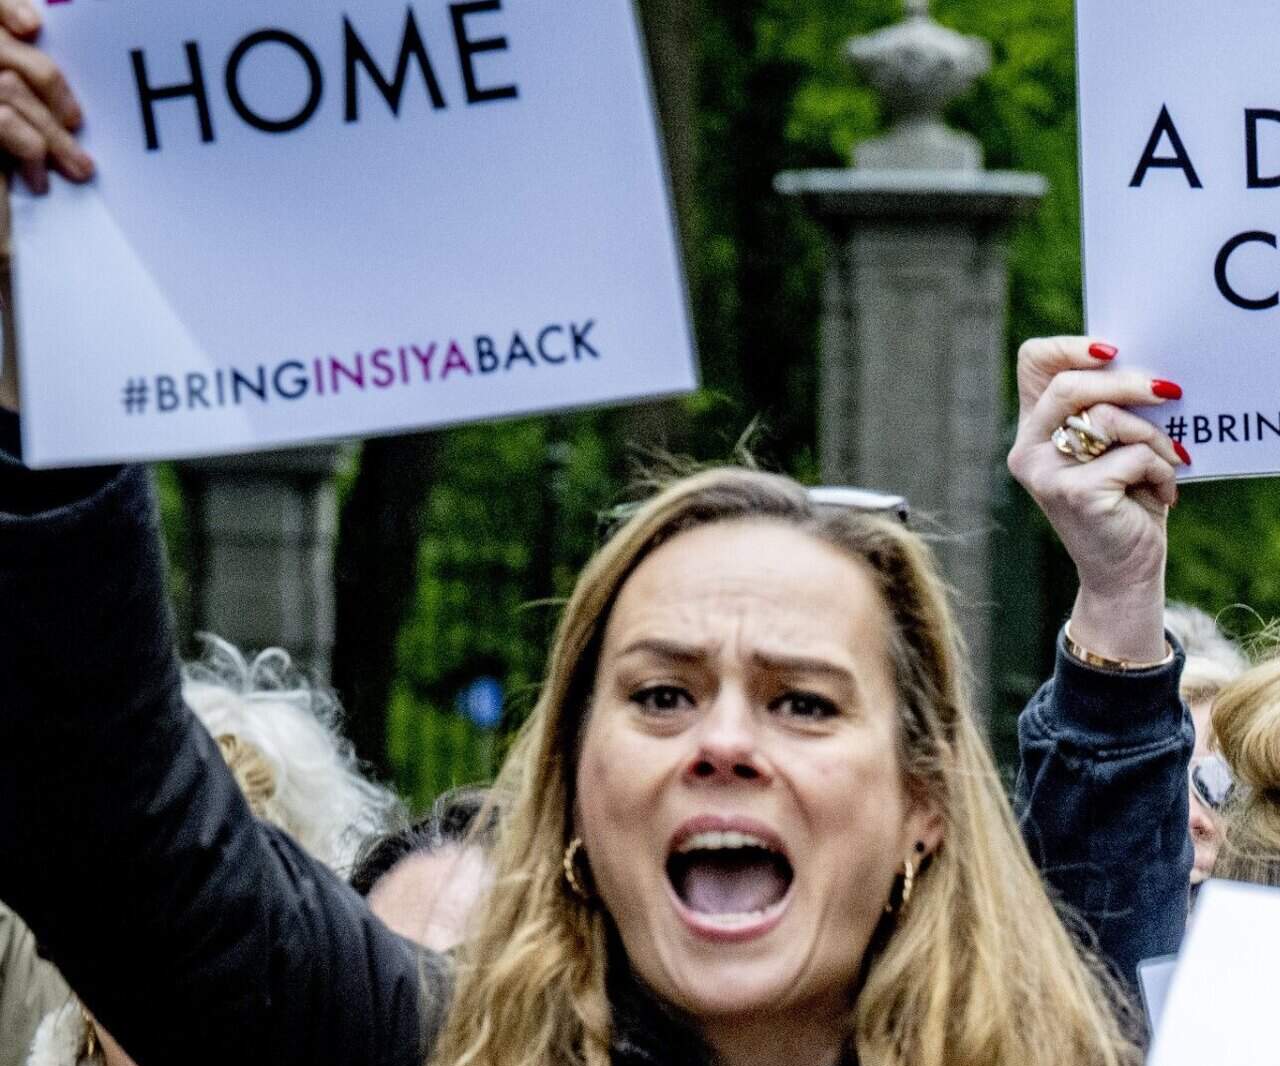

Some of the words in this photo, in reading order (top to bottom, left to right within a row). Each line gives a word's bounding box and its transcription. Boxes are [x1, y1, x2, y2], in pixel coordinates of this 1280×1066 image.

[129, 0, 520, 152] HOME
[1129, 103, 1204, 190] A
[122, 320, 600, 413] #BRINGINSIYABACK
